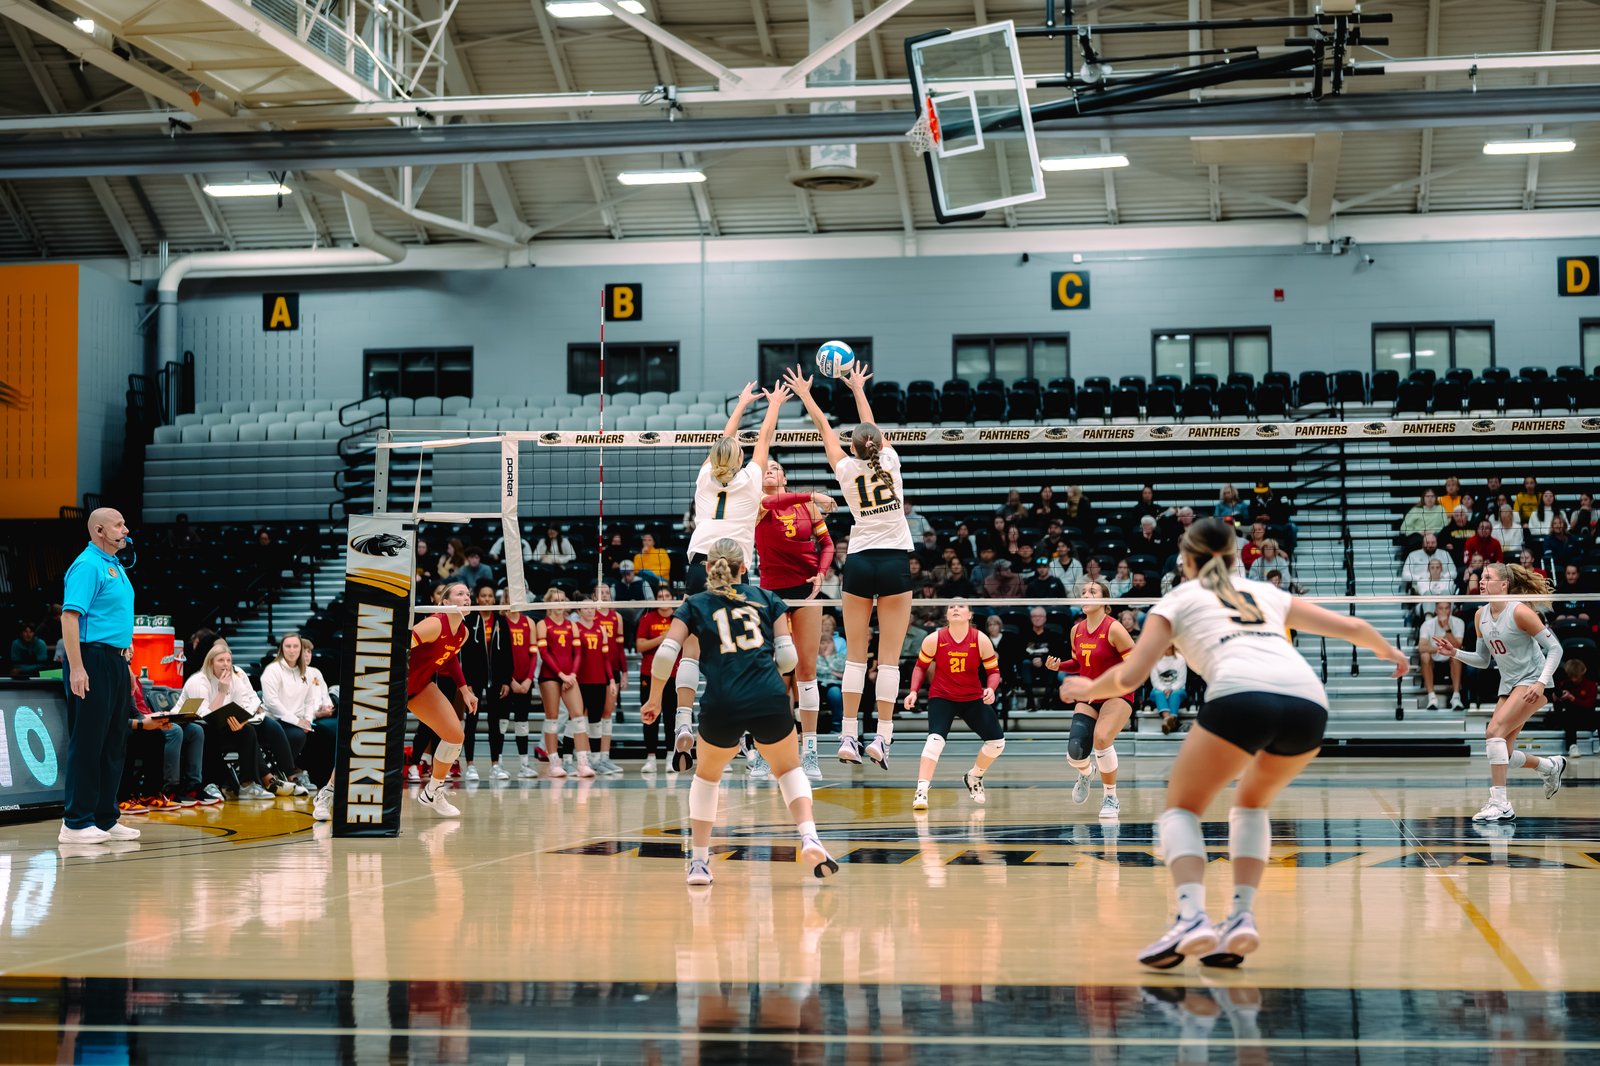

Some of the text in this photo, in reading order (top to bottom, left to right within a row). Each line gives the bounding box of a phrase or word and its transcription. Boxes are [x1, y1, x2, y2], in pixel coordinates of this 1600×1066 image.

[1567, 260, 1590, 293] D
[1058, 273, 1083, 307] C
[613, 287, 635, 318] B
[270, 296, 292, 328] A
[1188, 427, 1241, 437] PANTHERS
[1295, 425, 1348, 436] PANTHERS
[1403, 423, 1456, 434] PANTHERS
[1512, 420, 1565, 431] PANTHERS
[576, 434, 624, 444] PANTHERS
[675, 433, 723, 443] PANTHERS
[882, 431, 927, 441] ANTHERS
[979, 430, 1030, 440] PANTHERS
[1083, 428, 1135, 439] PANTHERS
[855, 474, 898, 508] 12
[713, 491, 728, 520] 1
[860, 503, 901, 517] MILWAUKEE
[784, 519, 797, 537] 3
[712, 606, 765, 654] 13
[512, 633, 524, 646] 19
[558, 634, 566, 647] 4
[587, 637, 598, 649] 17
[1489, 639, 1507, 654] 10
[950, 657, 966, 673] 21
[1082, 649, 1091, 667] 7
[346, 602, 394, 824] MILWAUKEE
